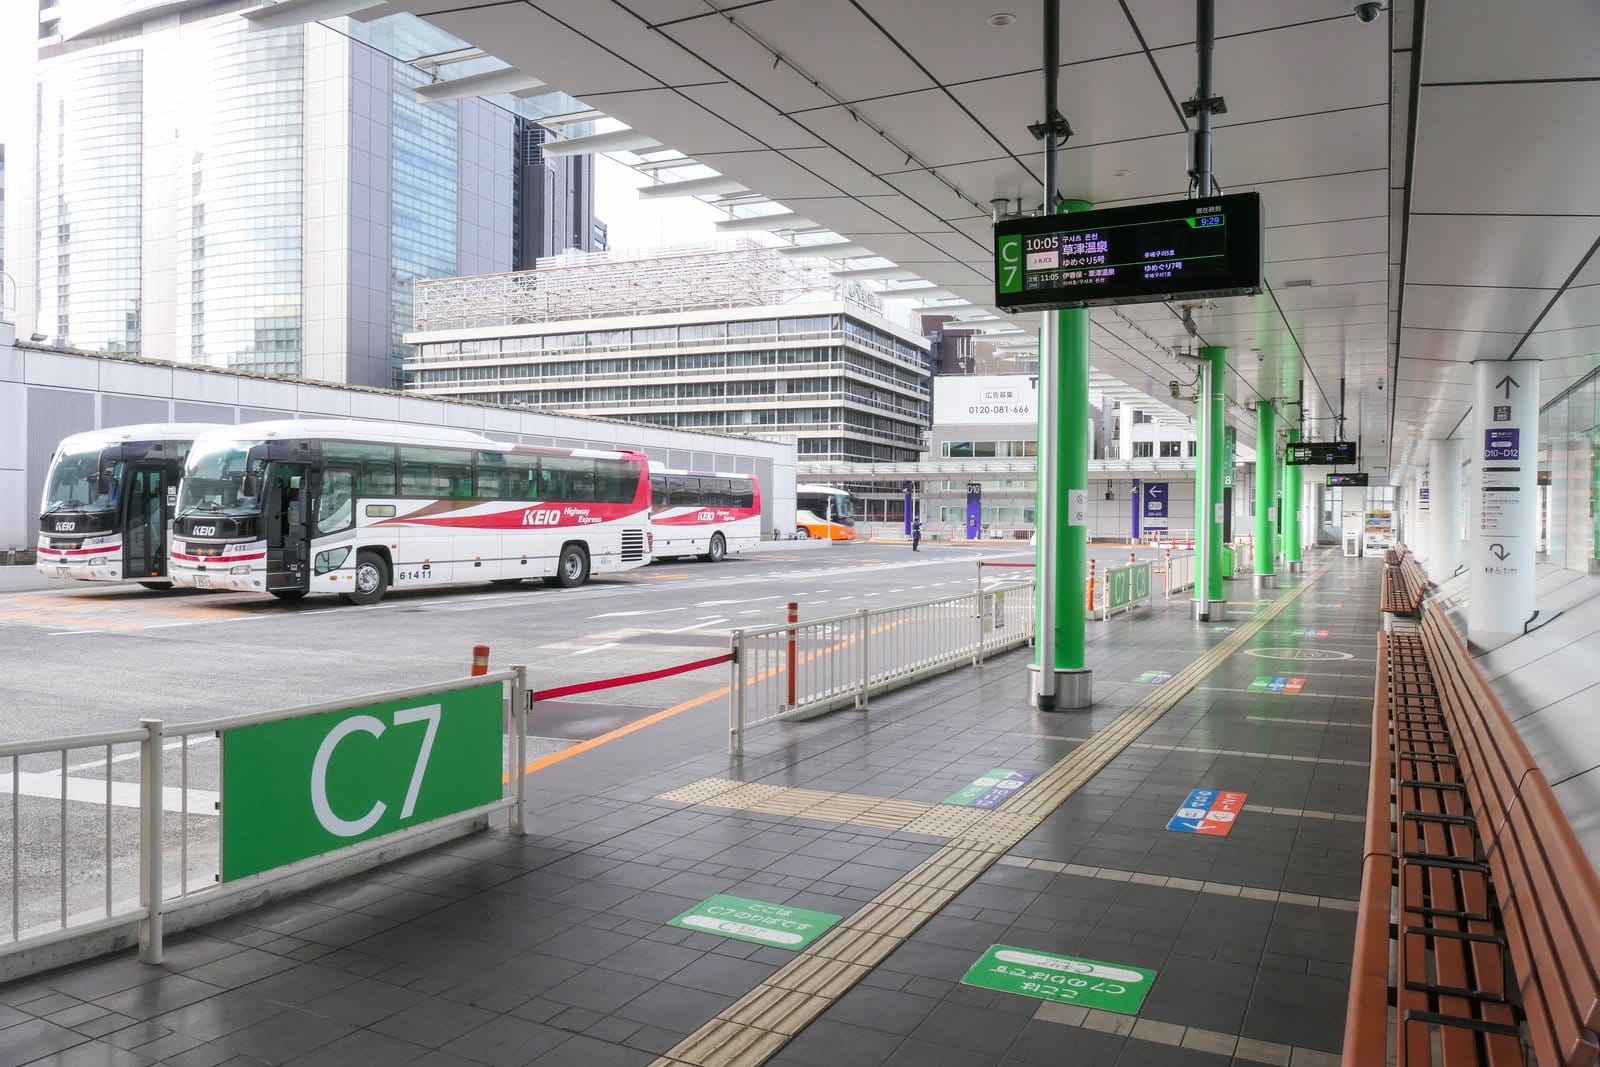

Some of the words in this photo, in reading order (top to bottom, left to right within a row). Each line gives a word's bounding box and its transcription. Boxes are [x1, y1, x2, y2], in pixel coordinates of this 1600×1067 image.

[1201, 216, 1220, 226] 9:29
[1026, 236, 1059, 251] 10:05
[1062, 240, 1108, 256] 草津温泉
[1062, 255, 1105, 267] ゆめぐり5号
[1040, 273, 1059, 282] 11:05
[968, 405, 1029, 414] 0120-081-666
[522, 509, 561, 525] KEIO
[563, 507, 590, 517] Highway
[578, 515, 602, 525] Express
[697, 511, 715, 521] KEIO
[55, 521, 76, 531] KEIO
[192, 525, 216, 536] KEIO
[400, 571, 432, 580] 61411
[1115, 572, 1126, 605] C7
[1136, 567, 1146, 598] C8
[310, 703, 441, 837] C7
[748, 903, 794, 917] ここは
[1020, 981, 1079, 999] ここは
